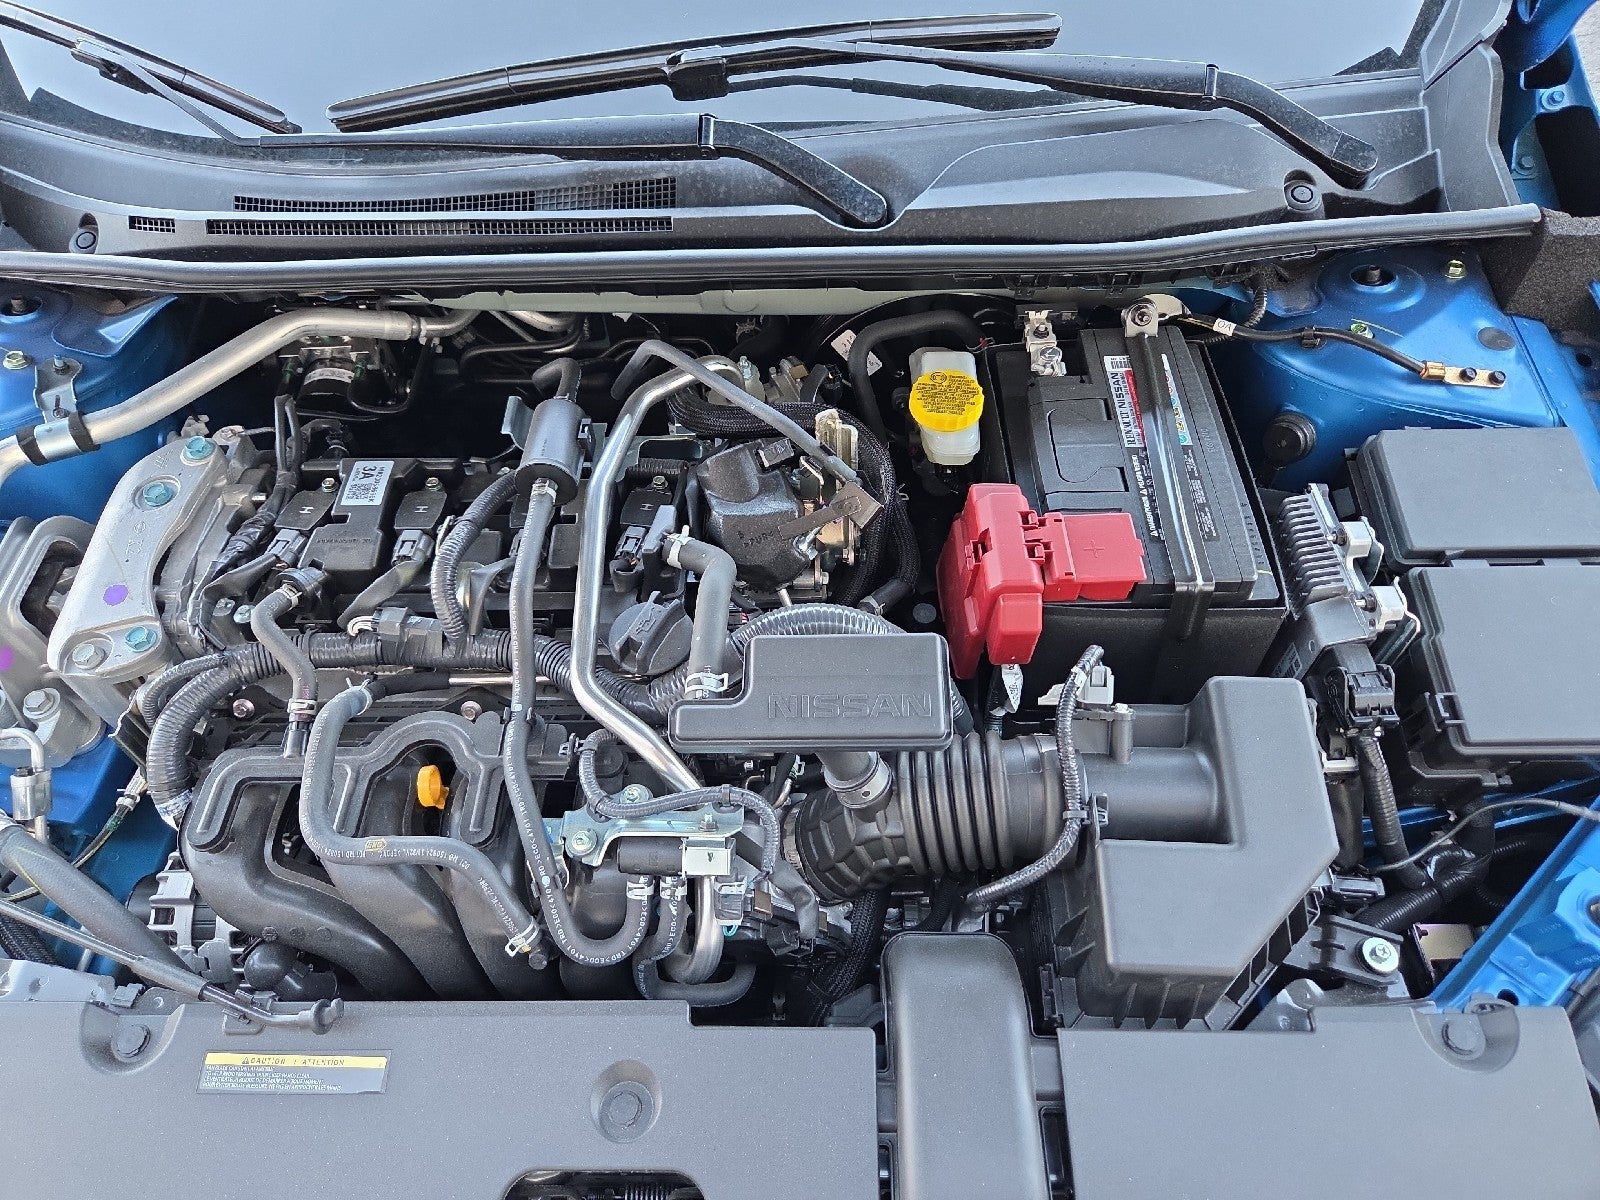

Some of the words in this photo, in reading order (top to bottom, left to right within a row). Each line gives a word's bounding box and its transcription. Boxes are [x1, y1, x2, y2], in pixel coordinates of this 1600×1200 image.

[1110, 372, 1127, 409] NISSAN
[358, 465, 377, 480] 3A
[768, 692, 933, 720] NISSAN
[250, 1057, 286, 1065] CAUTION
